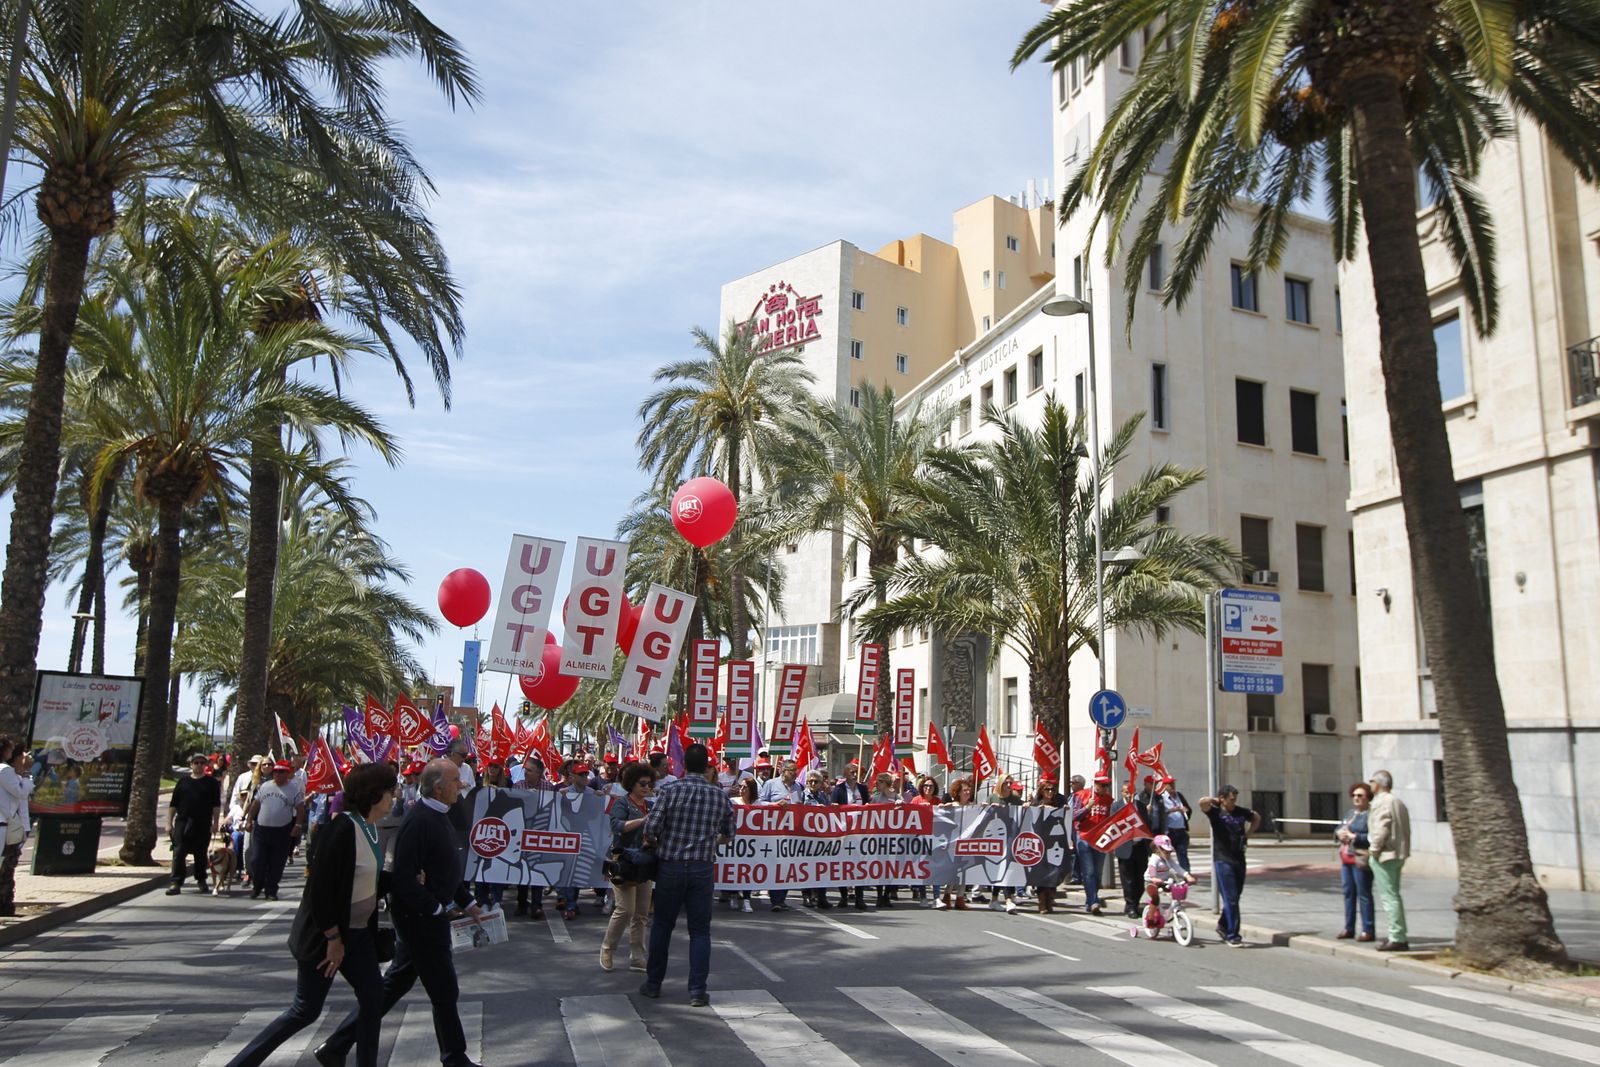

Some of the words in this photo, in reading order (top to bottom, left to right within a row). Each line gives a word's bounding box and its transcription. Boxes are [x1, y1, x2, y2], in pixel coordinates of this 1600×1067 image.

[776, 300, 822, 327] HOTEL
[745, 319, 818, 353] MERIA
[960, 370, 972, 388] DE
[978, 337, 1019, 376] JUSTICIA
[680, 500, 698, 512] UGT
[506, 544, 552, 652] UGT
[577, 546, 616, 655] UGT
[1226, 605, 1240, 624] P
[636, 594, 683, 696] UGT
[493, 656, 534, 670] ALMERÍA
[566, 660, 606, 672] ALMERÍA
[89, 683, 120, 691] COVAP
[694, 643, 715, 721] CCOO
[858, 647, 877, 718] CCOO
[620, 696, 658, 714] ALMERÍA
[730, 665, 750, 740] CCOO
[776, 669, 803, 740] CCOO
[899, 672, 912, 743] CCOO
[1035, 734, 1060, 765] COO
[476, 824, 506, 841] UGT
[525, 834, 577, 849] CCOO
[1017, 838, 1039, 852] UGT
[777, 839, 842, 858] IGUALDAD
[860, 834, 932, 855] COHESIÓN
[958, 842, 1000, 852] CCOO
[775, 863, 809, 883] LAS
[816, 860, 931, 881] PERSONAS
